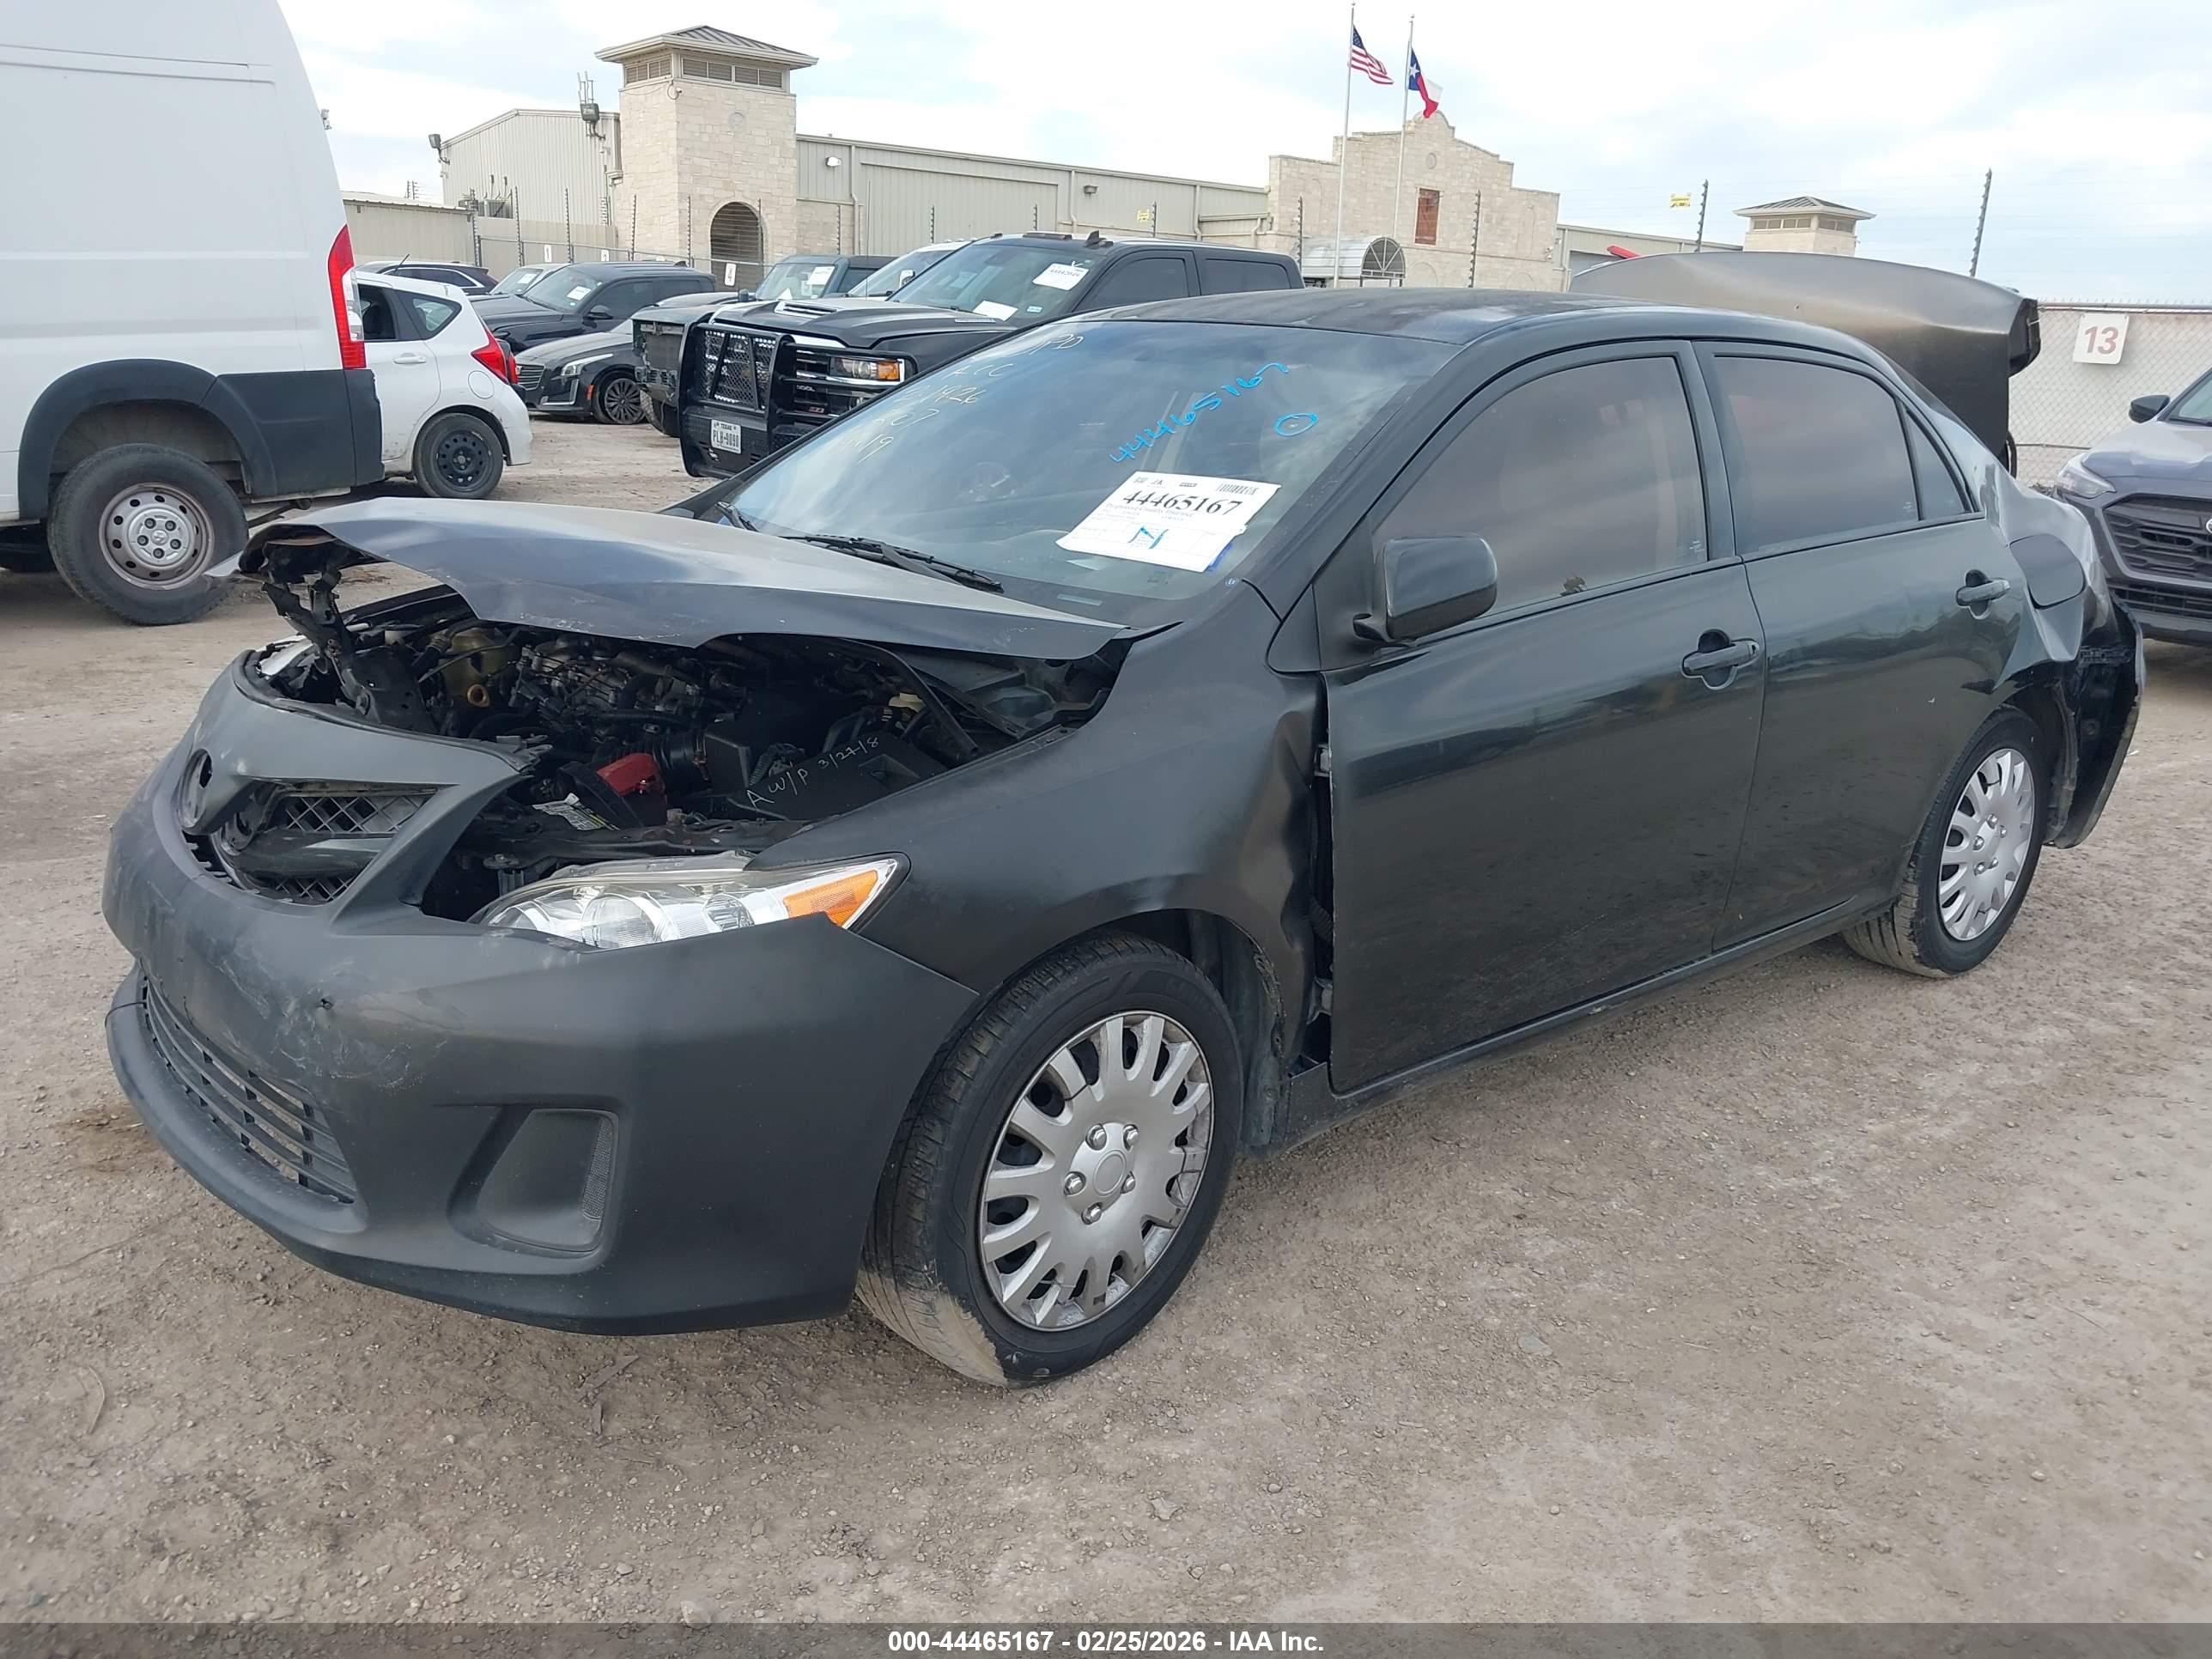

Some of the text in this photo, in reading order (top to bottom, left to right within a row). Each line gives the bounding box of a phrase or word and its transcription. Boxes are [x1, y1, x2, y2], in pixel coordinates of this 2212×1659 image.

[2085, 326, 2118, 355] 13
[1123, 490, 1243, 515] 44465167
[746, 789, 775, 811] A
